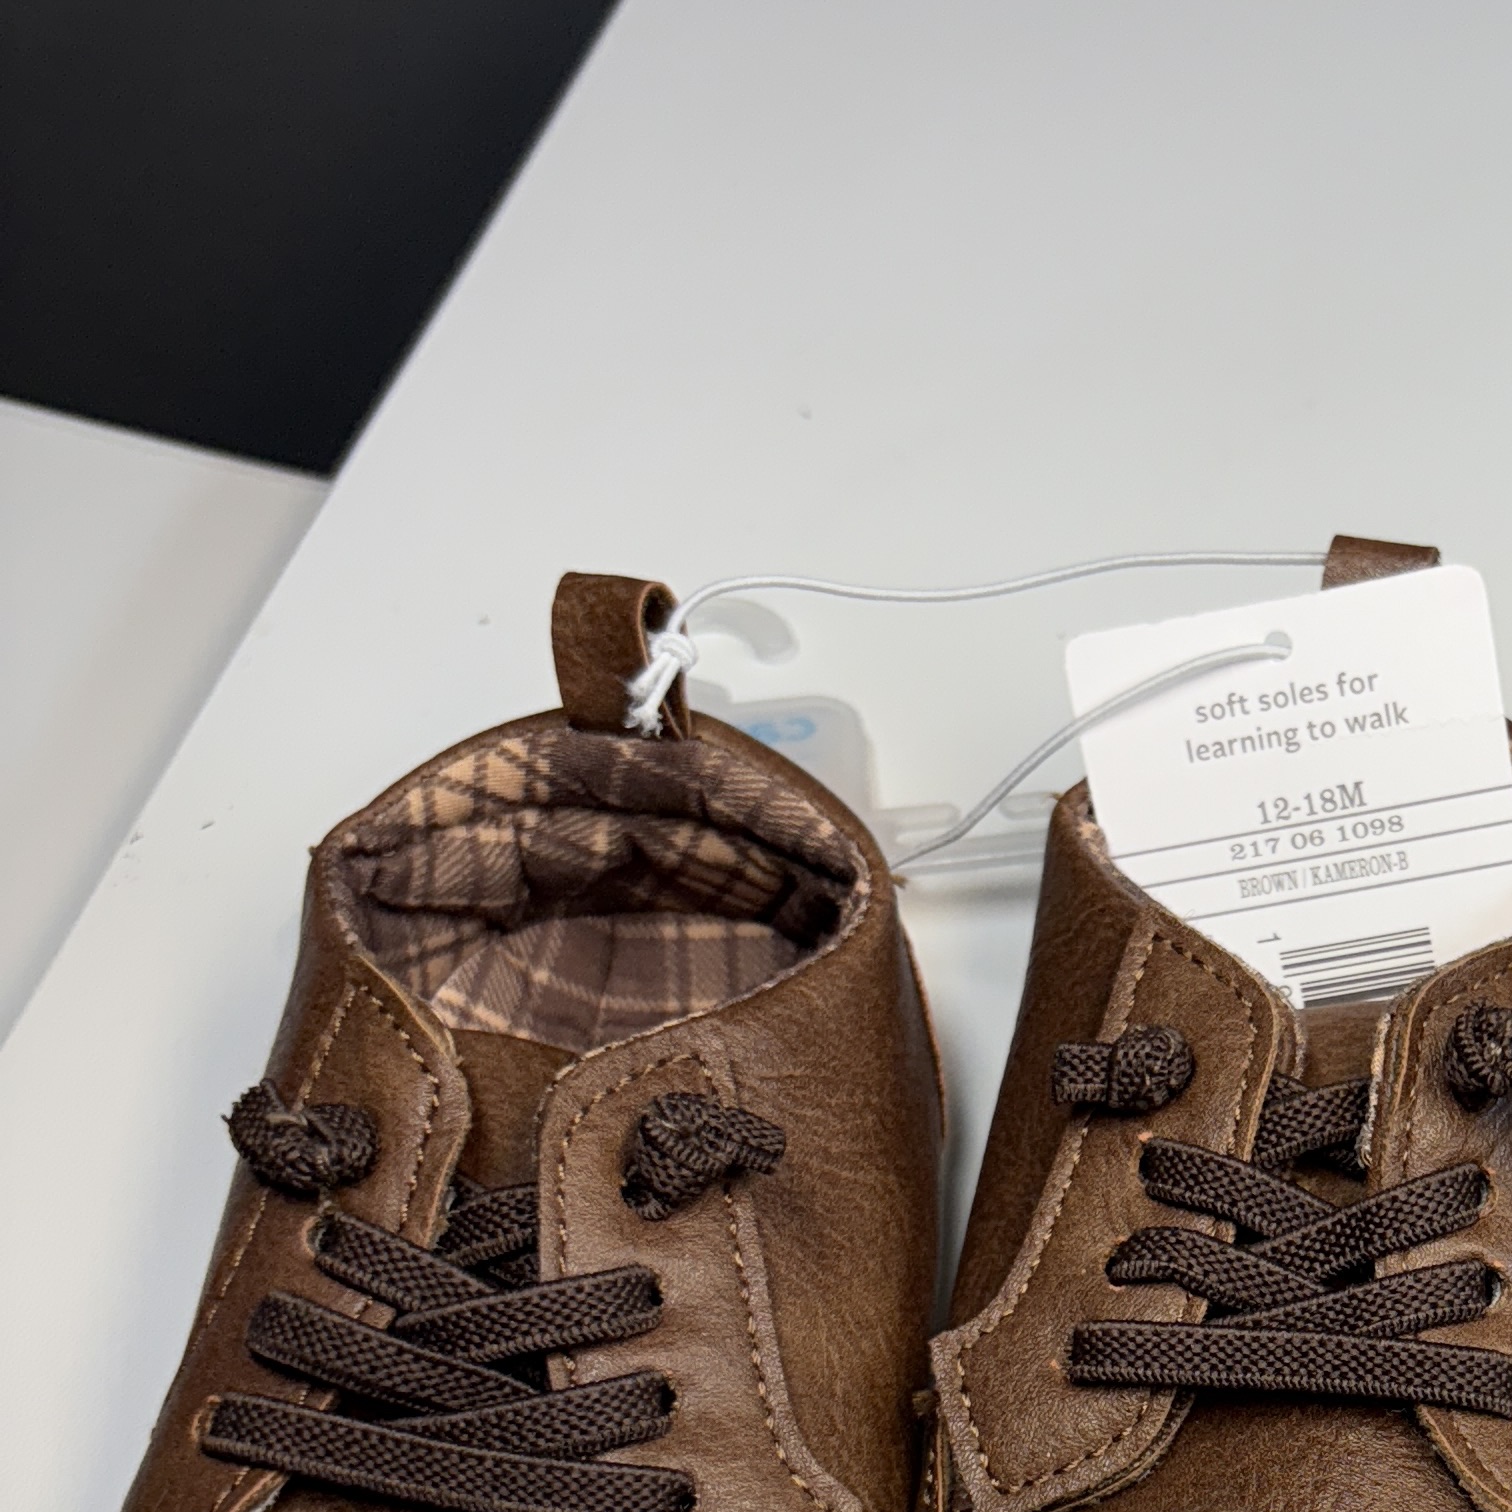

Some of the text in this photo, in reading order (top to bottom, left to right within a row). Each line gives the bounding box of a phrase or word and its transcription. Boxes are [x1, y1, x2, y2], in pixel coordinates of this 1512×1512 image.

[1194, 671, 1379, 724] soft soles for
[1185, 701, 1410, 763] learning to walk
[1257, 781, 1368, 825] 12-18M
[1229, 815, 1406, 861] 217 06 1098
